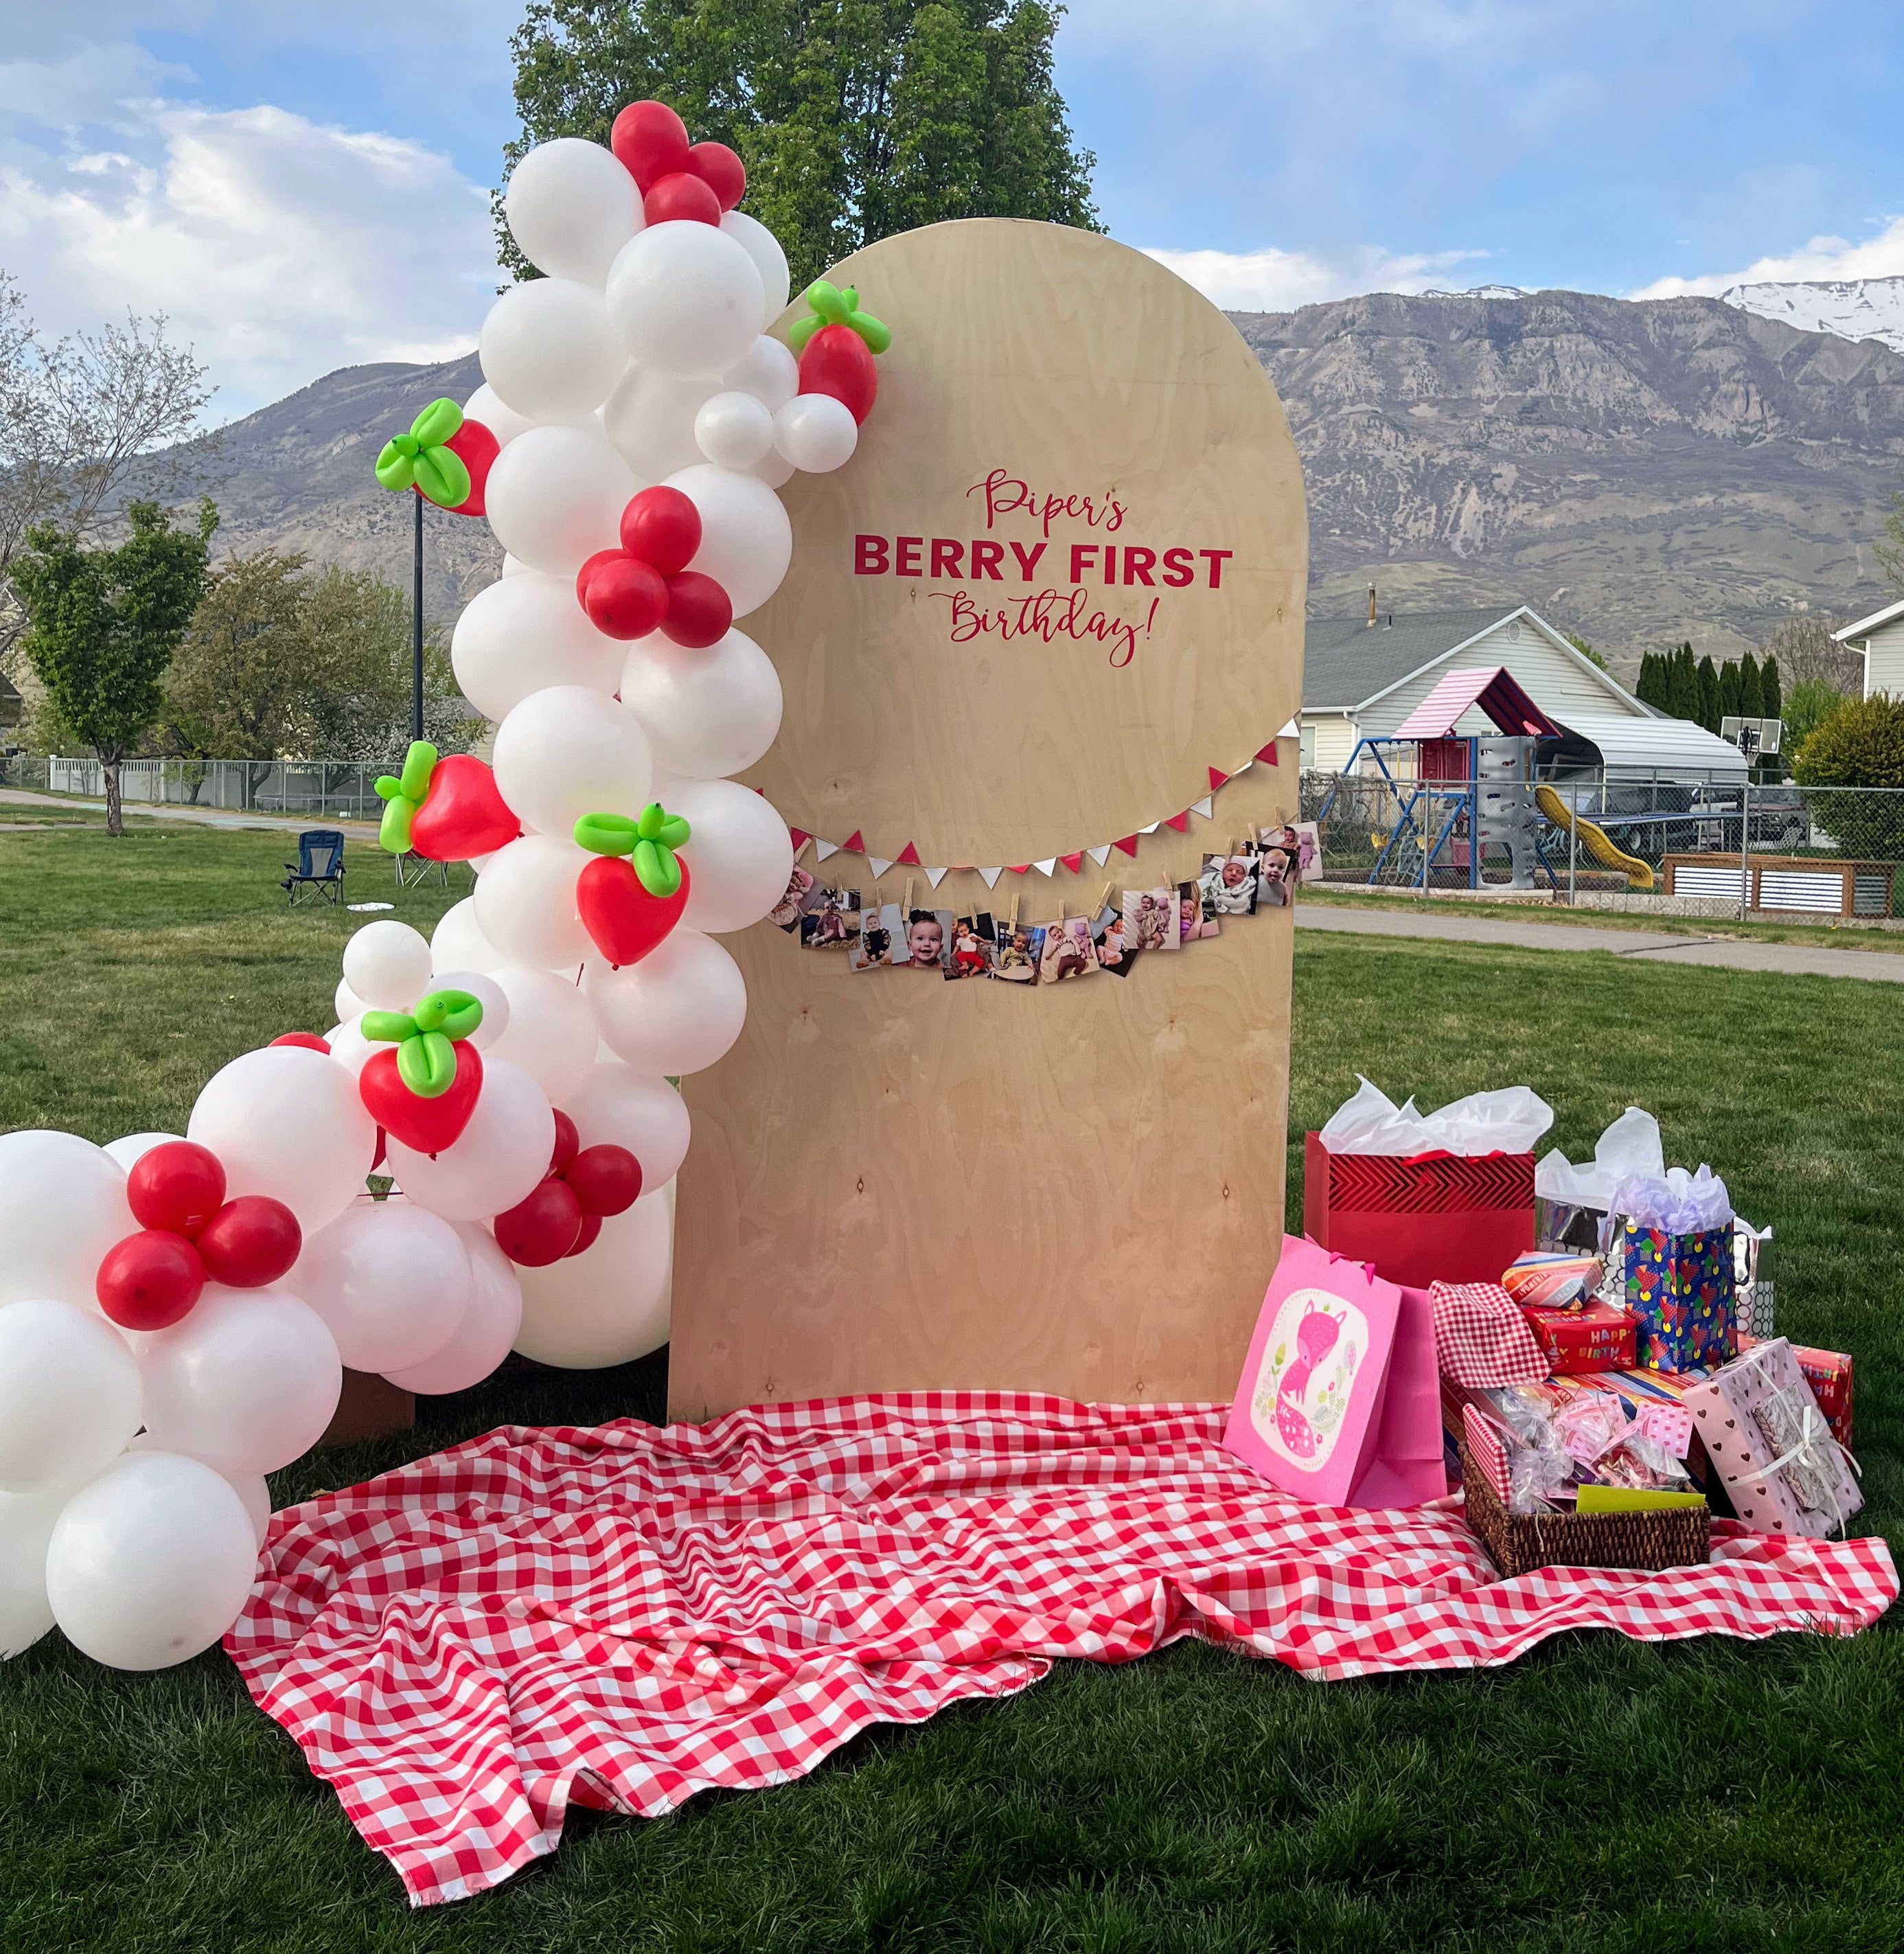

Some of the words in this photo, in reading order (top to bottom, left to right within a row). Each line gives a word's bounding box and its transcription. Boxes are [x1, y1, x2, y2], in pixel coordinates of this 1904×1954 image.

[967, 469, 1127, 538] Piper's
[854, 534, 1048, 582] BERRY
[1070, 544, 1233, 589] FIRST
[928, 588, 1160, 668] Birthday!
[1591, 1329, 1631, 1344] HAPP
